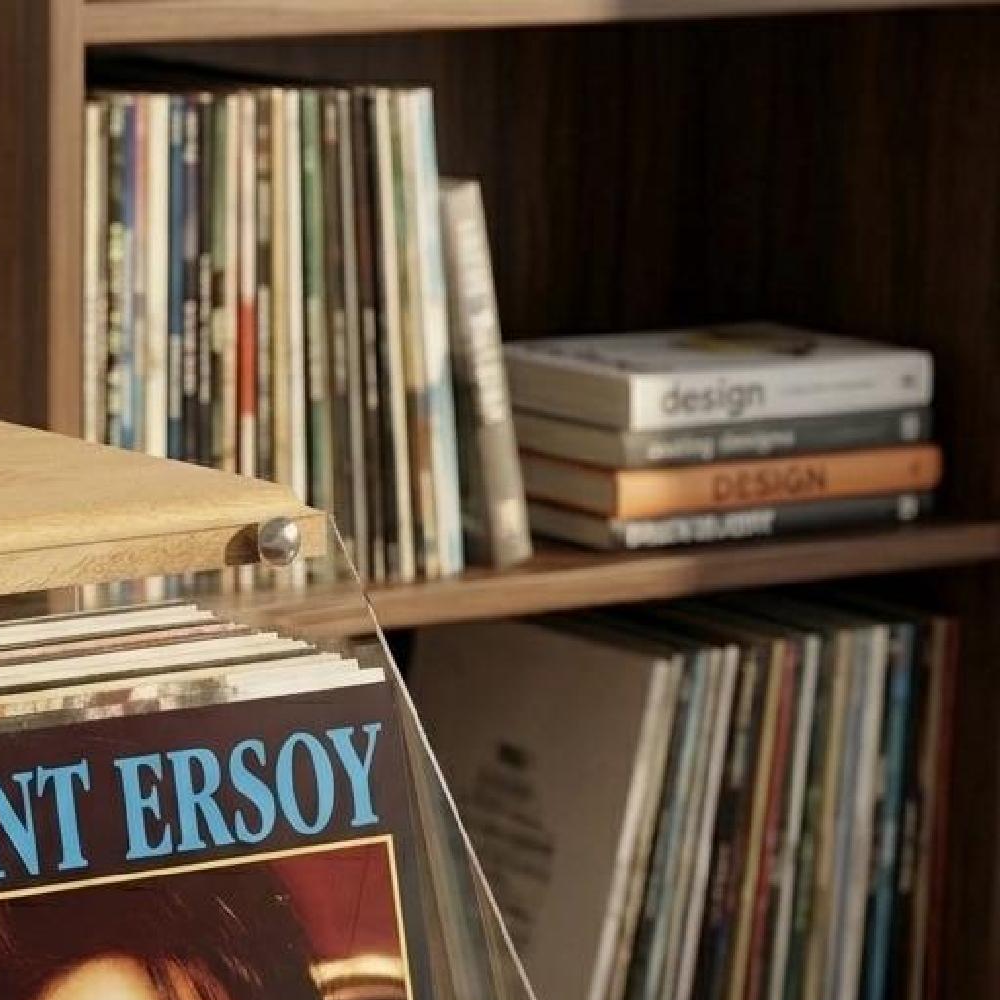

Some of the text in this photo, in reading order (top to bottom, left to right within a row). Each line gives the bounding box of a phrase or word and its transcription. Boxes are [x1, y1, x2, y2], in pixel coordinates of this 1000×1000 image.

[661, 376, 766, 417] design
[712, 463, 828, 502] DESIGN
[114, 722, 382, 861] ERSOY
